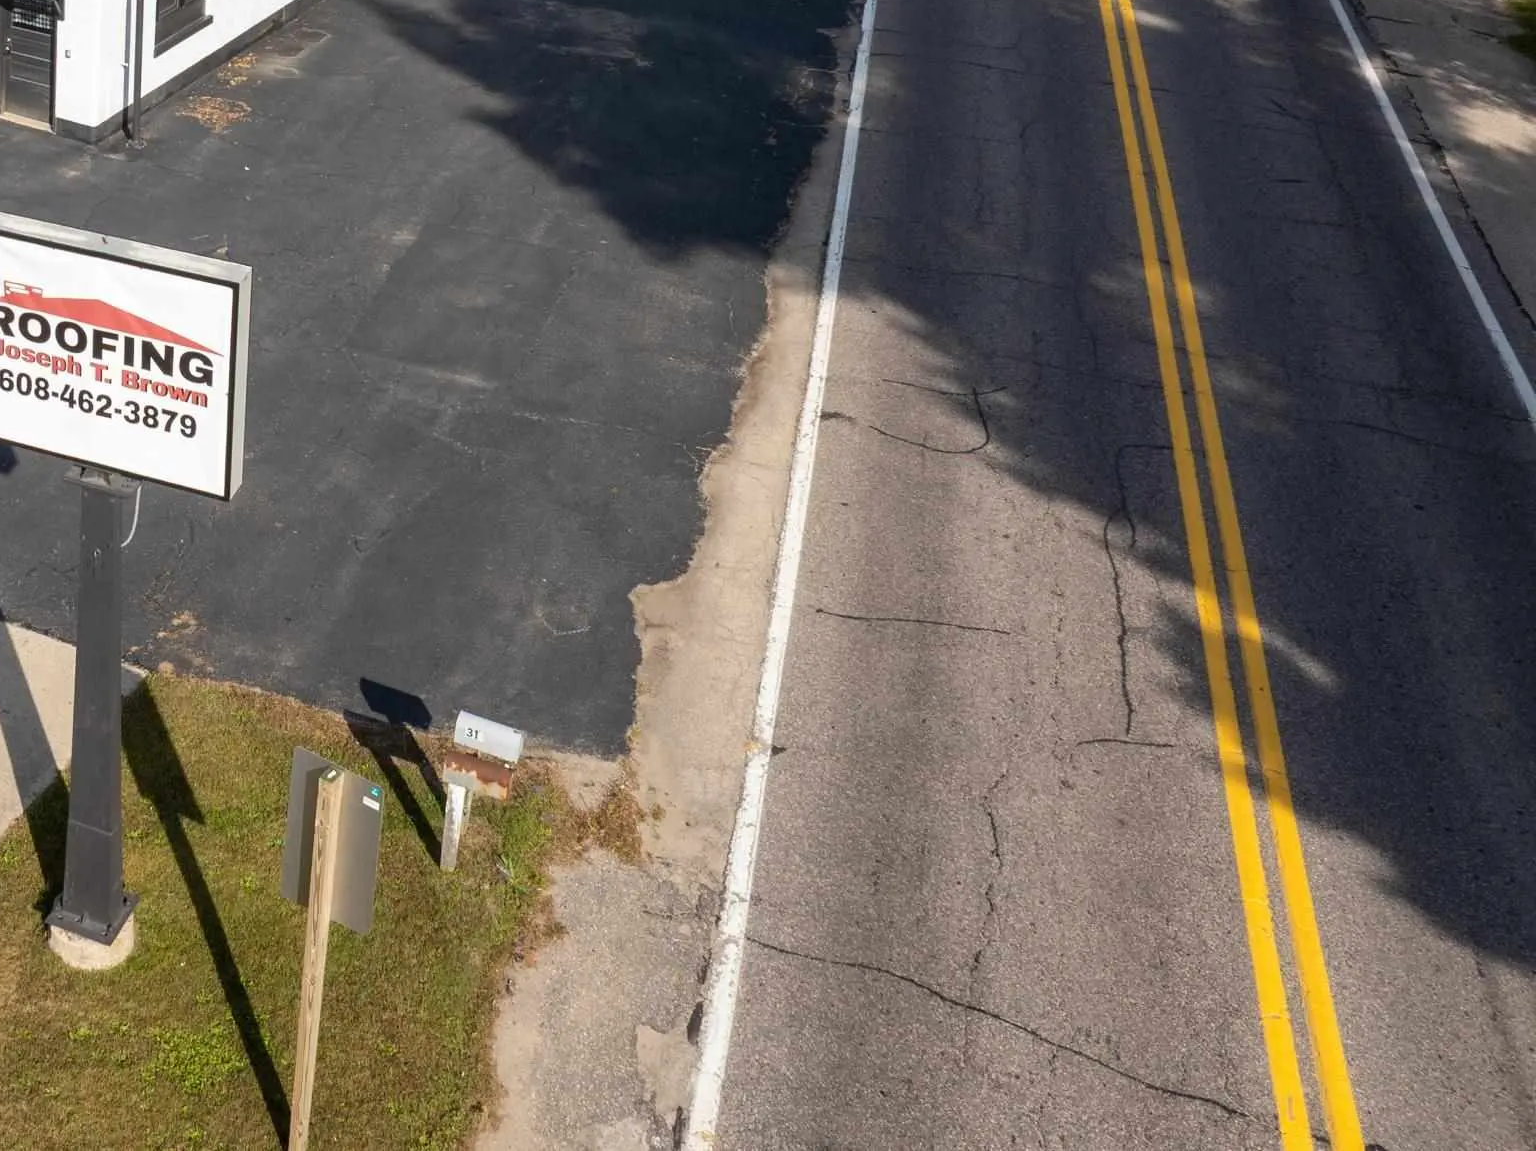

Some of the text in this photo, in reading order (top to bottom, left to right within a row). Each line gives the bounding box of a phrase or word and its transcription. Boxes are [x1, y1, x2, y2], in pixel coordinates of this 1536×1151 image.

[90, 361, 113, 384] T.
[121, 369, 208, 408] Brown
[466, 727, 479, 739] 31
